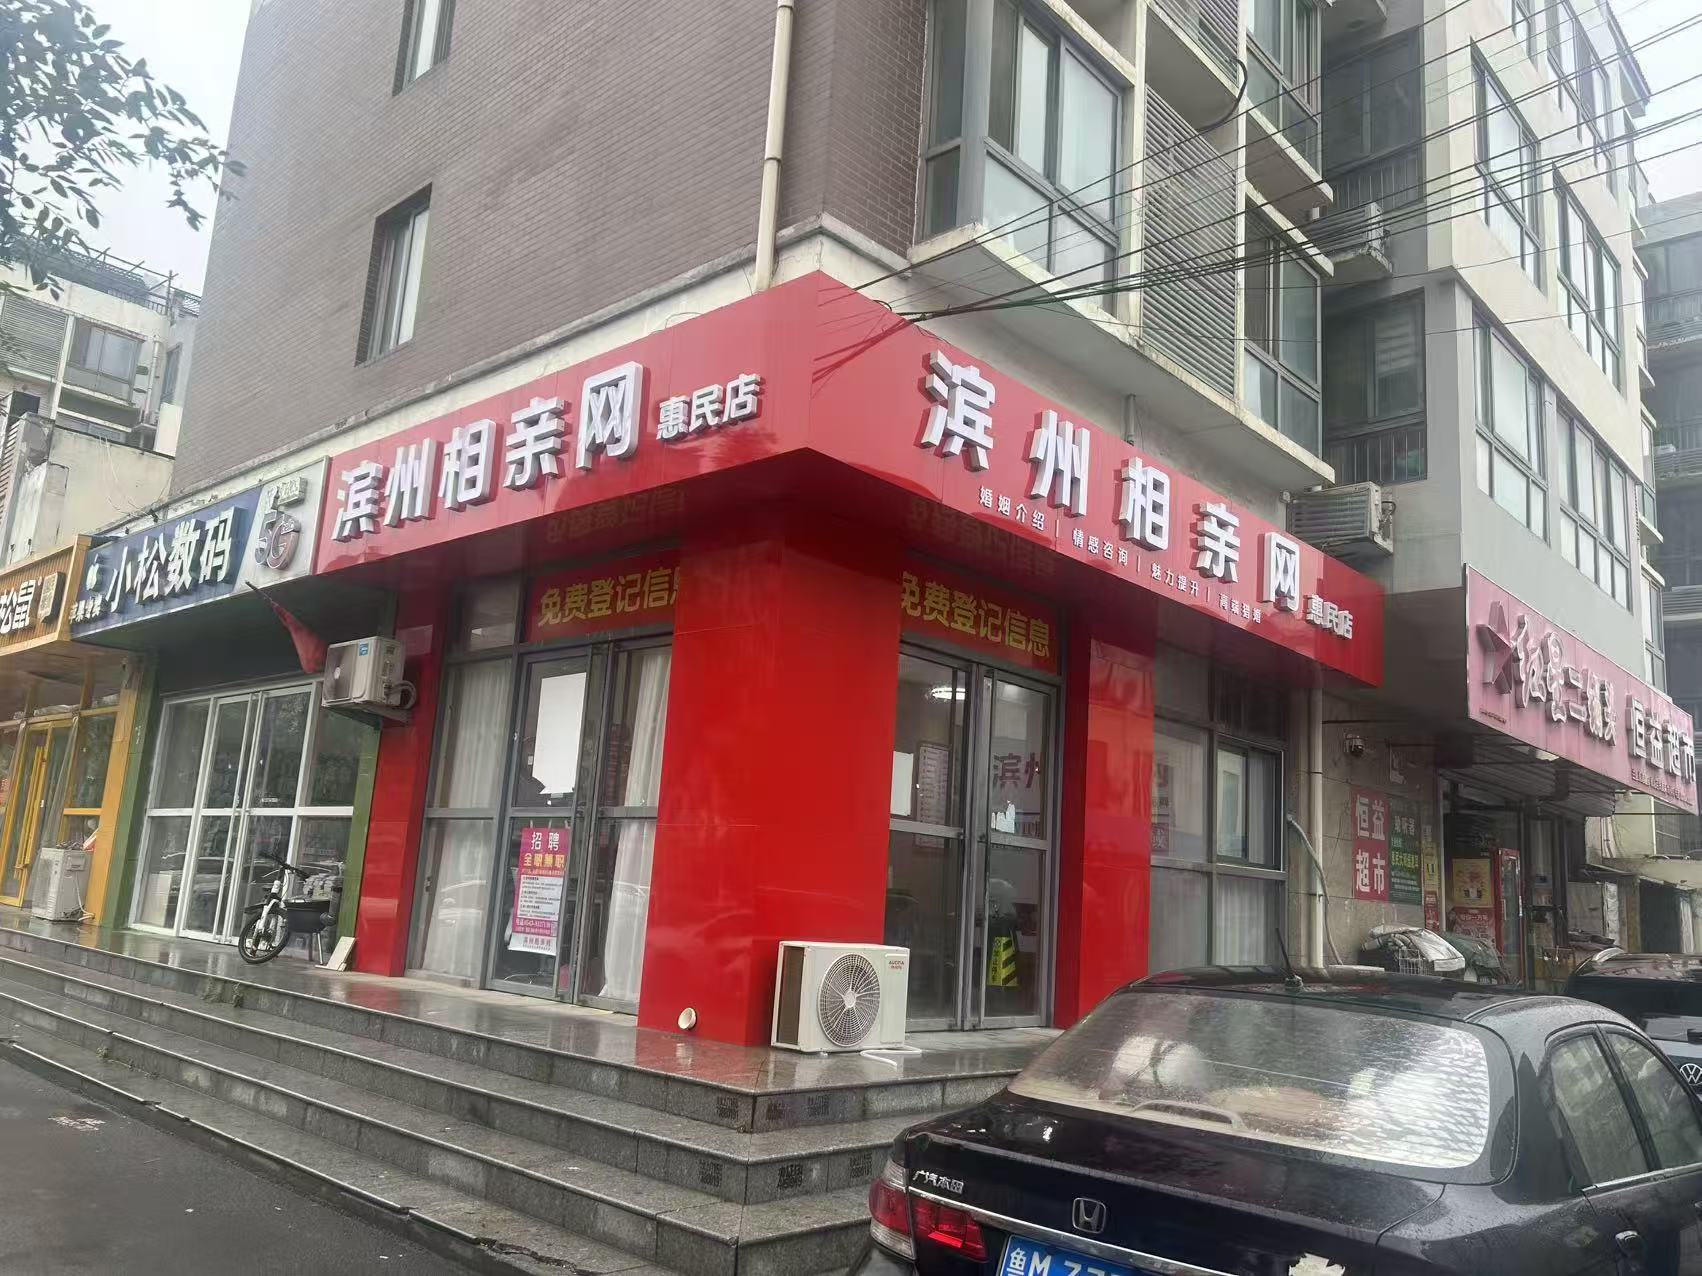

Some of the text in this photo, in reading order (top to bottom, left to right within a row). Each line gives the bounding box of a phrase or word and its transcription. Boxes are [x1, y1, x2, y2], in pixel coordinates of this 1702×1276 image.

[331, 361, 761, 543] 滨州相亲网 惠民店
[920, 349, 1354, 641] 滨州相亲网 惠民店
[106, 506, 238, 613] 小松数码
[979, 485, 1046, 532] 婚姻介绍
[1072, 527, 1128, 566] 情感咨询
[1151, 560, 1200, 598] 魅力提升
[900, 570, 1050, 658] 免费登记信息
[531, 831, 560, 852] 招聘
[1355, 793, 1386, 841] 恒益
[1355, 848, 1386, 895] 超市
[912, 1169, 964, 1194] 广汽本田
